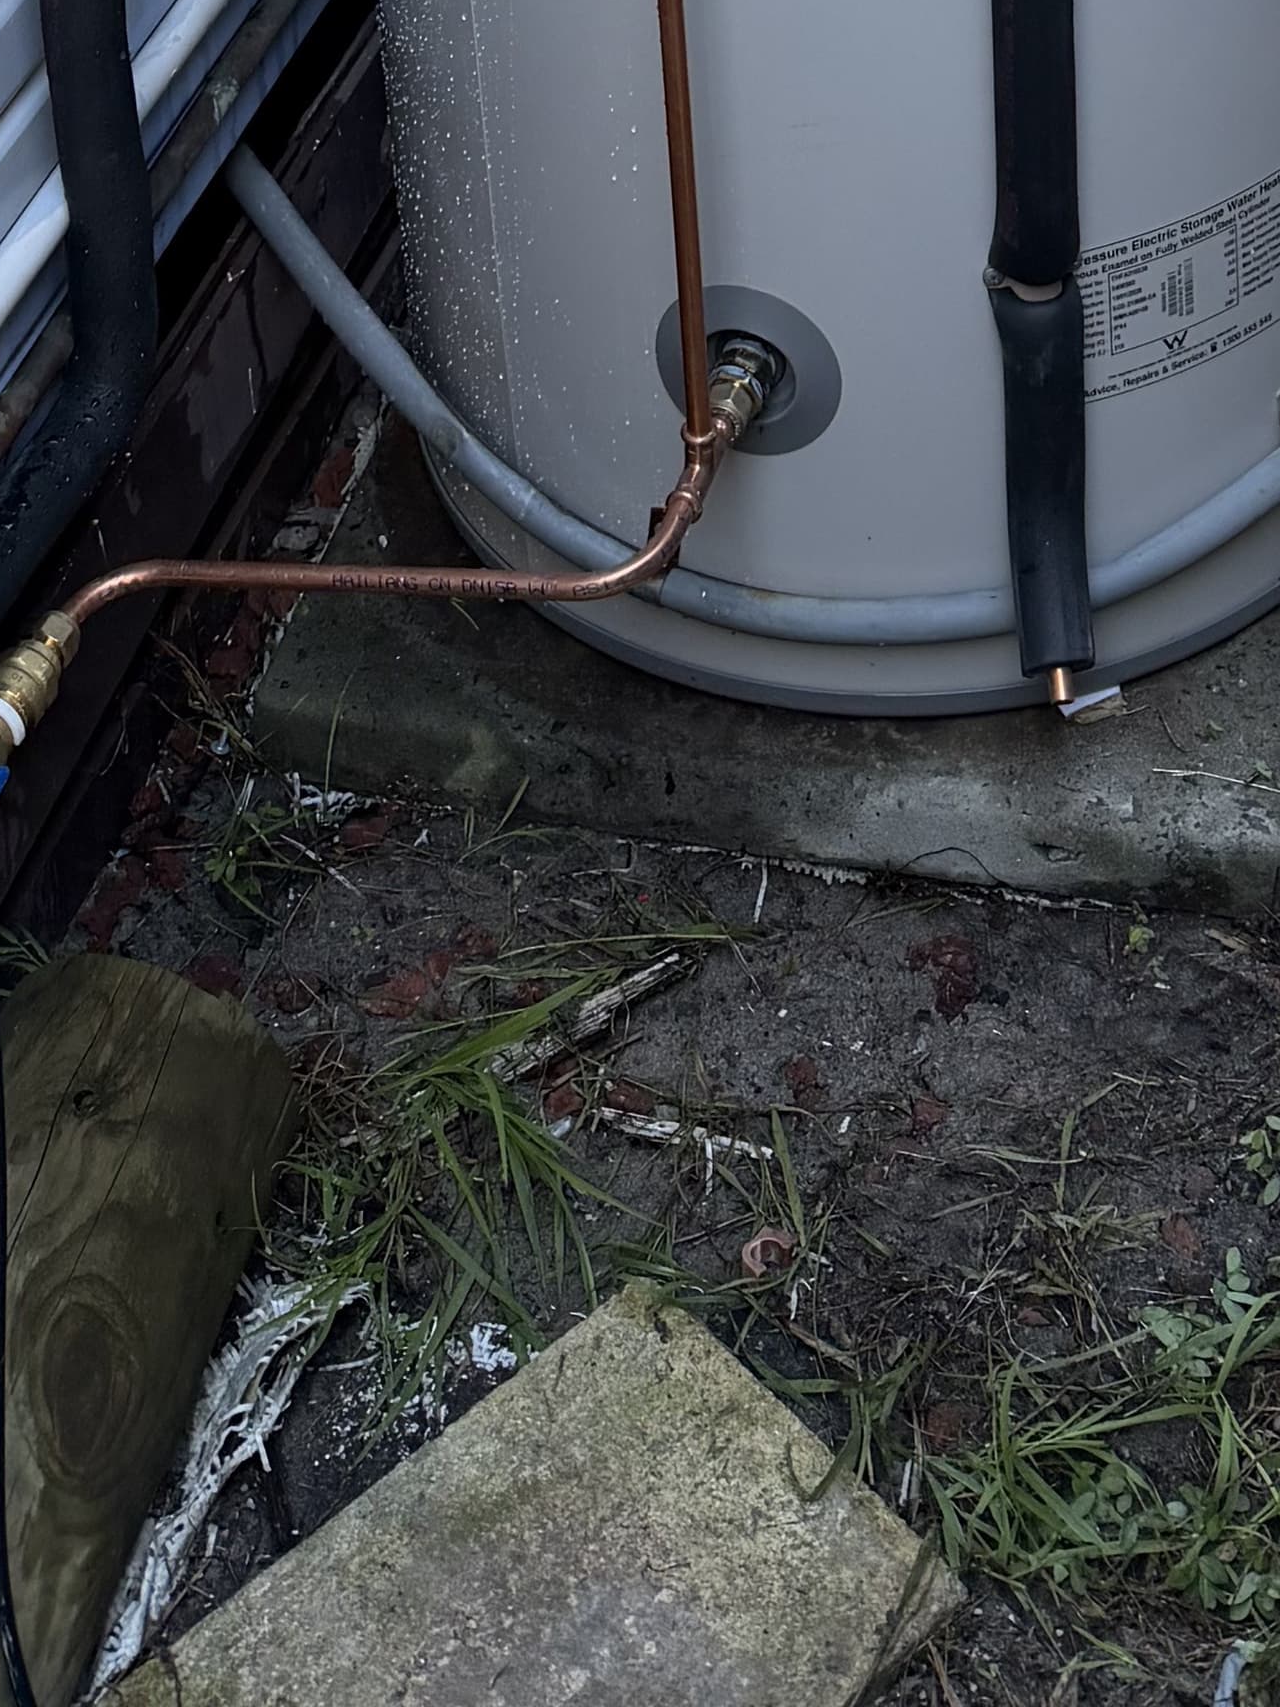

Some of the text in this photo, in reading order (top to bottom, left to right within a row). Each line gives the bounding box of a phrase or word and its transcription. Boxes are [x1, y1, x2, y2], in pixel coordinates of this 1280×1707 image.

[1079, 245, 1128, 266] ressure
[1131, 228, 1178, 251] Electric
[1180, 207, 1225, 234] Storage
[1227, 190, 1258, 212] Water
[1101, 254, 1138, 273] Enamel
[1140, 251, 1153, 261] on
[1155, 242, 1178, 256] Fully
[1179, 224, 1214, 246] Welded
[1215, 213, 1237, 232] Steel
[1123, 369, 1159, 388] Repairs
[1222, 331, 1242, 346] 1300
[332, 573, 418, 591] HAILIANG
[428, 577, 451, 592] CN
